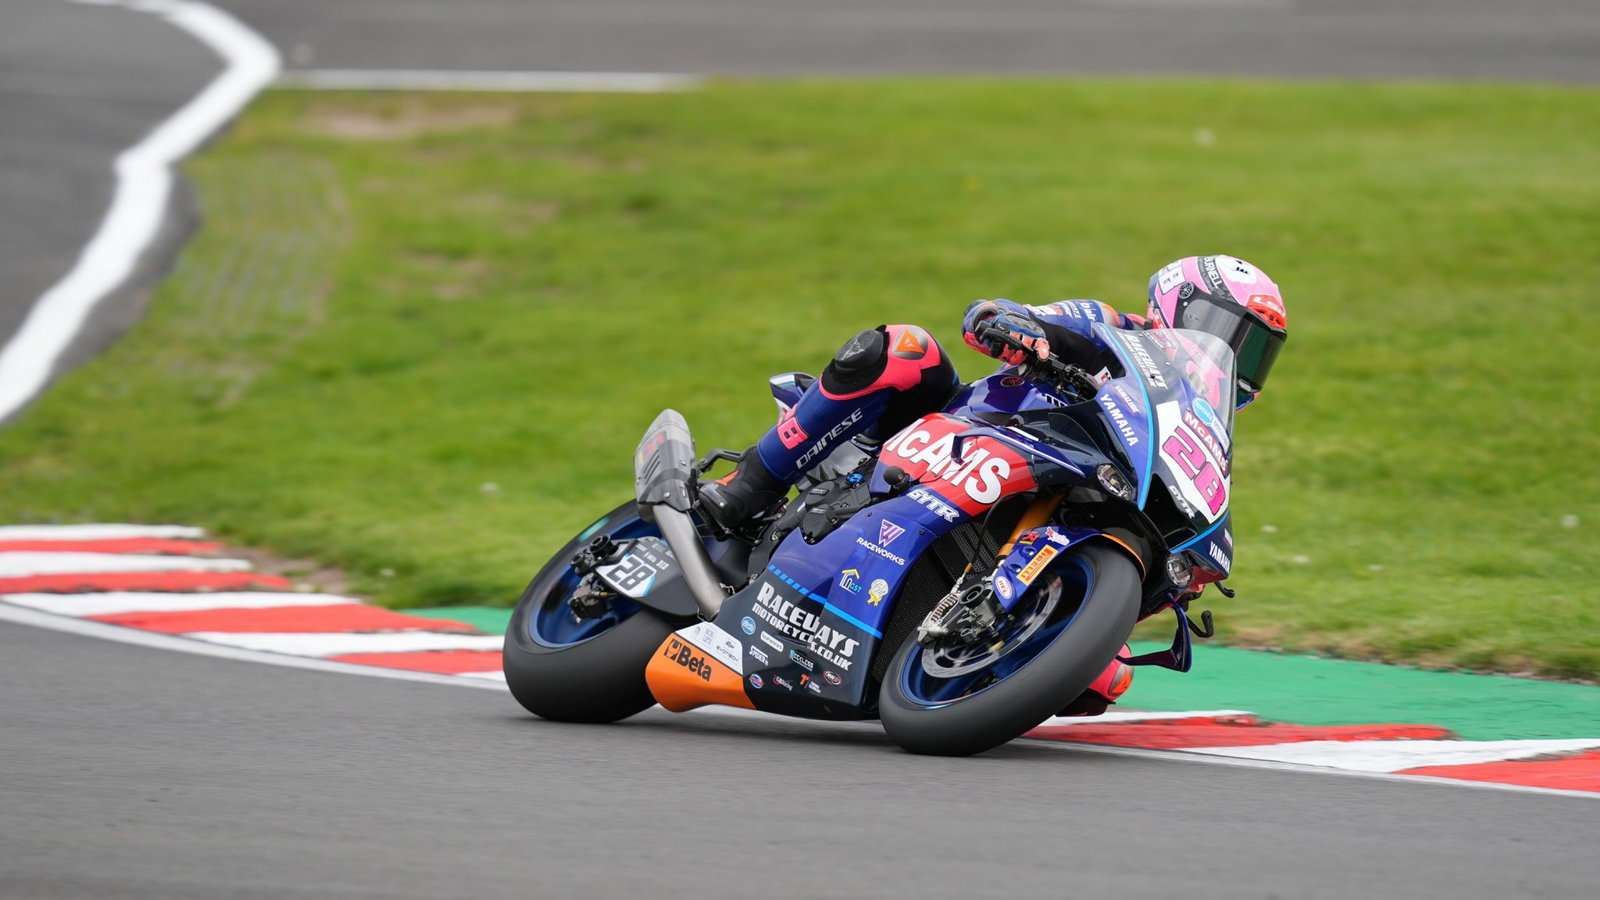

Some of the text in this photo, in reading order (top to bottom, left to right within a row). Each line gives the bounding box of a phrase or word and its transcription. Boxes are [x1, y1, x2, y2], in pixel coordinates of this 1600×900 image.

[1100, 393, 1139, 447] YAMAHA
[796, 407, 864, 470] DAINESE
[1162, 426, 1226, 516] 28
[906, 488, 960, 523] GYTR
[1168, 485, 1195, 519] GYTR
[856, 536, 906, 566] RACEWORKS
[606, 556, 657, 591] 28
[676, 645, 712, 682] Beta
